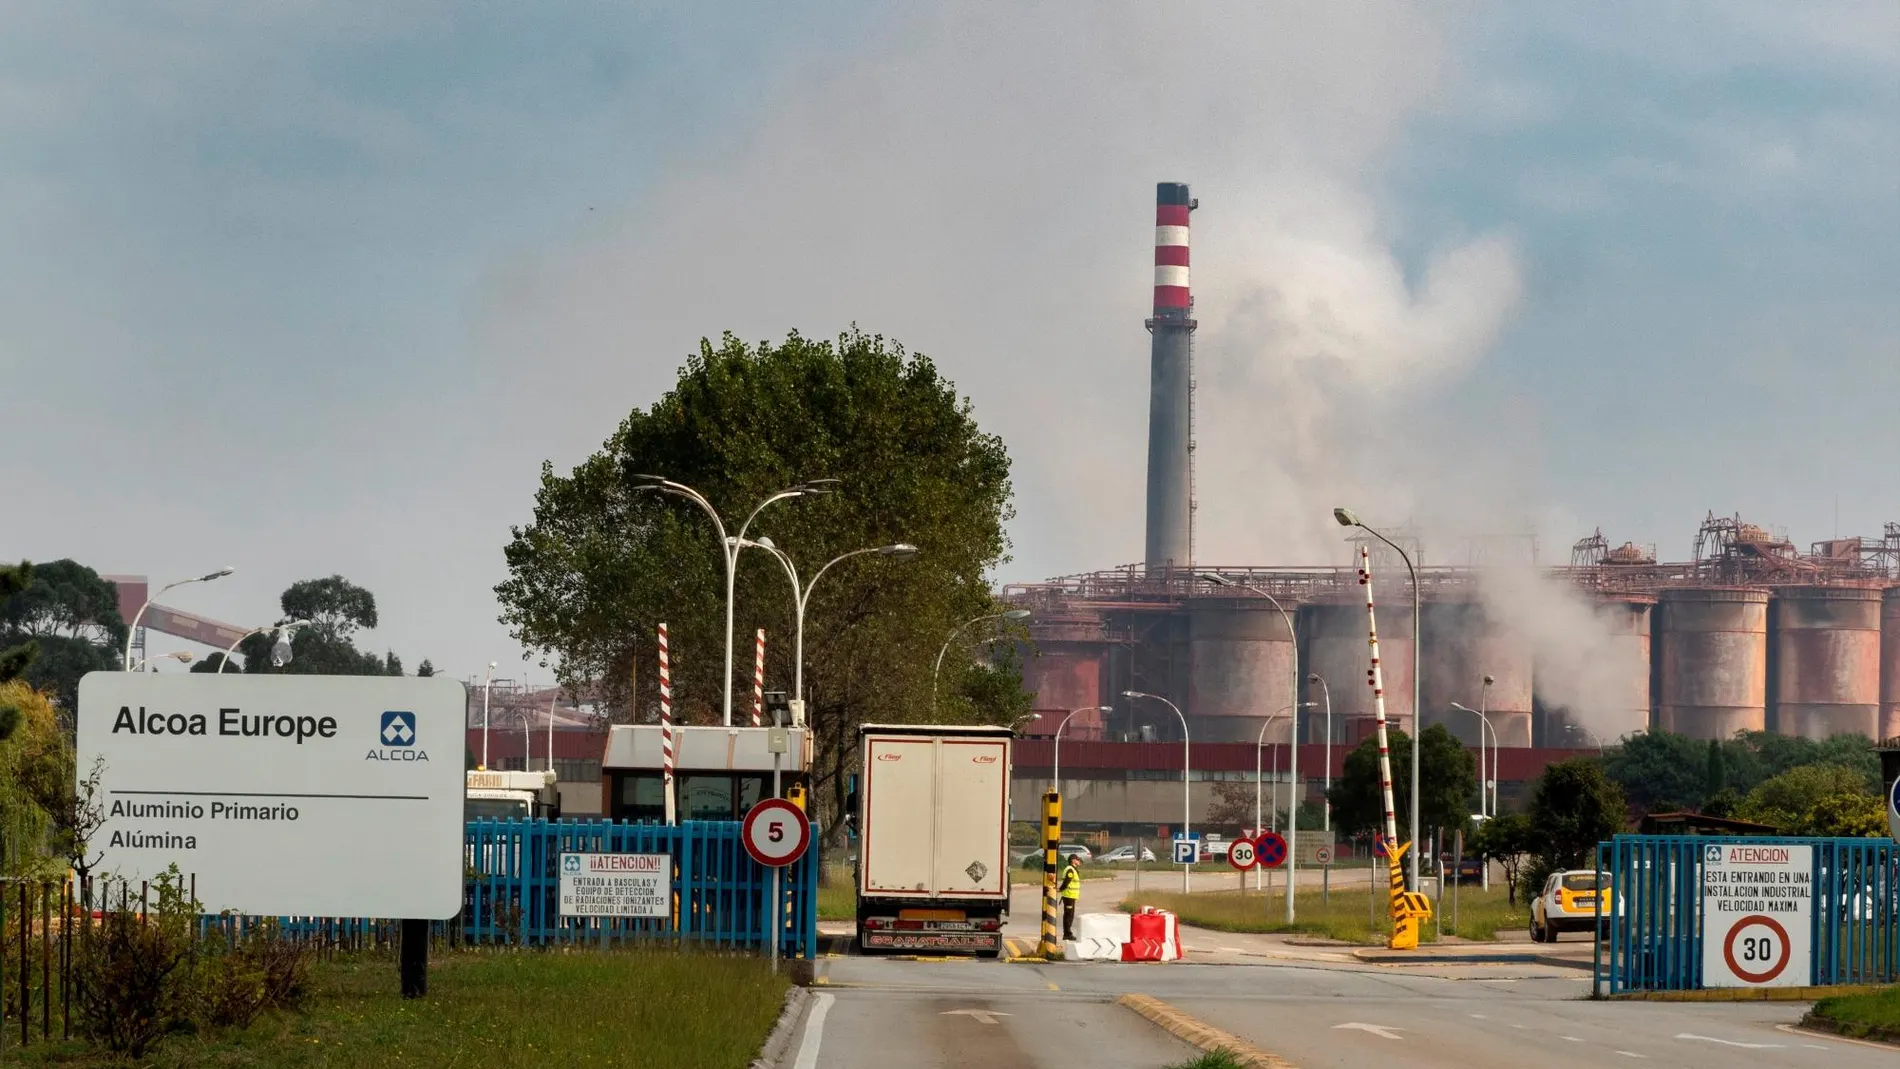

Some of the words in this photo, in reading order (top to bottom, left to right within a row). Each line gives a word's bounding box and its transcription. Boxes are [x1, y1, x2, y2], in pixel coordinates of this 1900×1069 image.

[112, 706, 207, 736] Alcoa
[218, 708, 338, 744] Europe
[365, 749, 429, 761] ALCOA
[110, 800, 204, 819] Aluminio
[211, 802, 299, 821] Primario
[768, 821, 784, 842] 5
[109, 830, 197, 849] Alúmina
[1178, 844, 1192, 862] P
[1235, 849, 1253, 860] 30
[1729, 848, 1789, 862] ATENCION
[573, 877, 605, 887] ENTRADA
[607, 878, 612, 887] A
[614, 878, 651, 887] BASCULAS
[653, 879, 658, 887] Y
[1706, 871, 1727, 883] ESTA
[1731, 871, 1775, 884] ENTRANDO
[1779, 872, 1790, 884] EN
[1793, 872, 1810, 884] UNA
[576, 886, 601, 895] EQUIPO
[604, 887, 613, 895] DE
[615, 887, 655, 896] DETECCION
[1705, 885, 1759, 898] INSTALACION
[1762, 886, 1811, 898] INDUSTRIAL
[564, 896, 573, 904] DE
[576, 896, 621, 905] RADIACIONES
[623, 897, 665, 905] IONIZANTES
[1717, 899, 1764, 912] VELOCIDAD
[1768, 900, 1798, 912] MAXIMA
[576, 905, 614, 914] VELOCIDAD
[616, 905, 647, 914] LIMITADA
[649, 905, 654, 914] A
[870, 935, 995, 946] GRANATRAILER
[1743, 937, 1771, 961] 30
